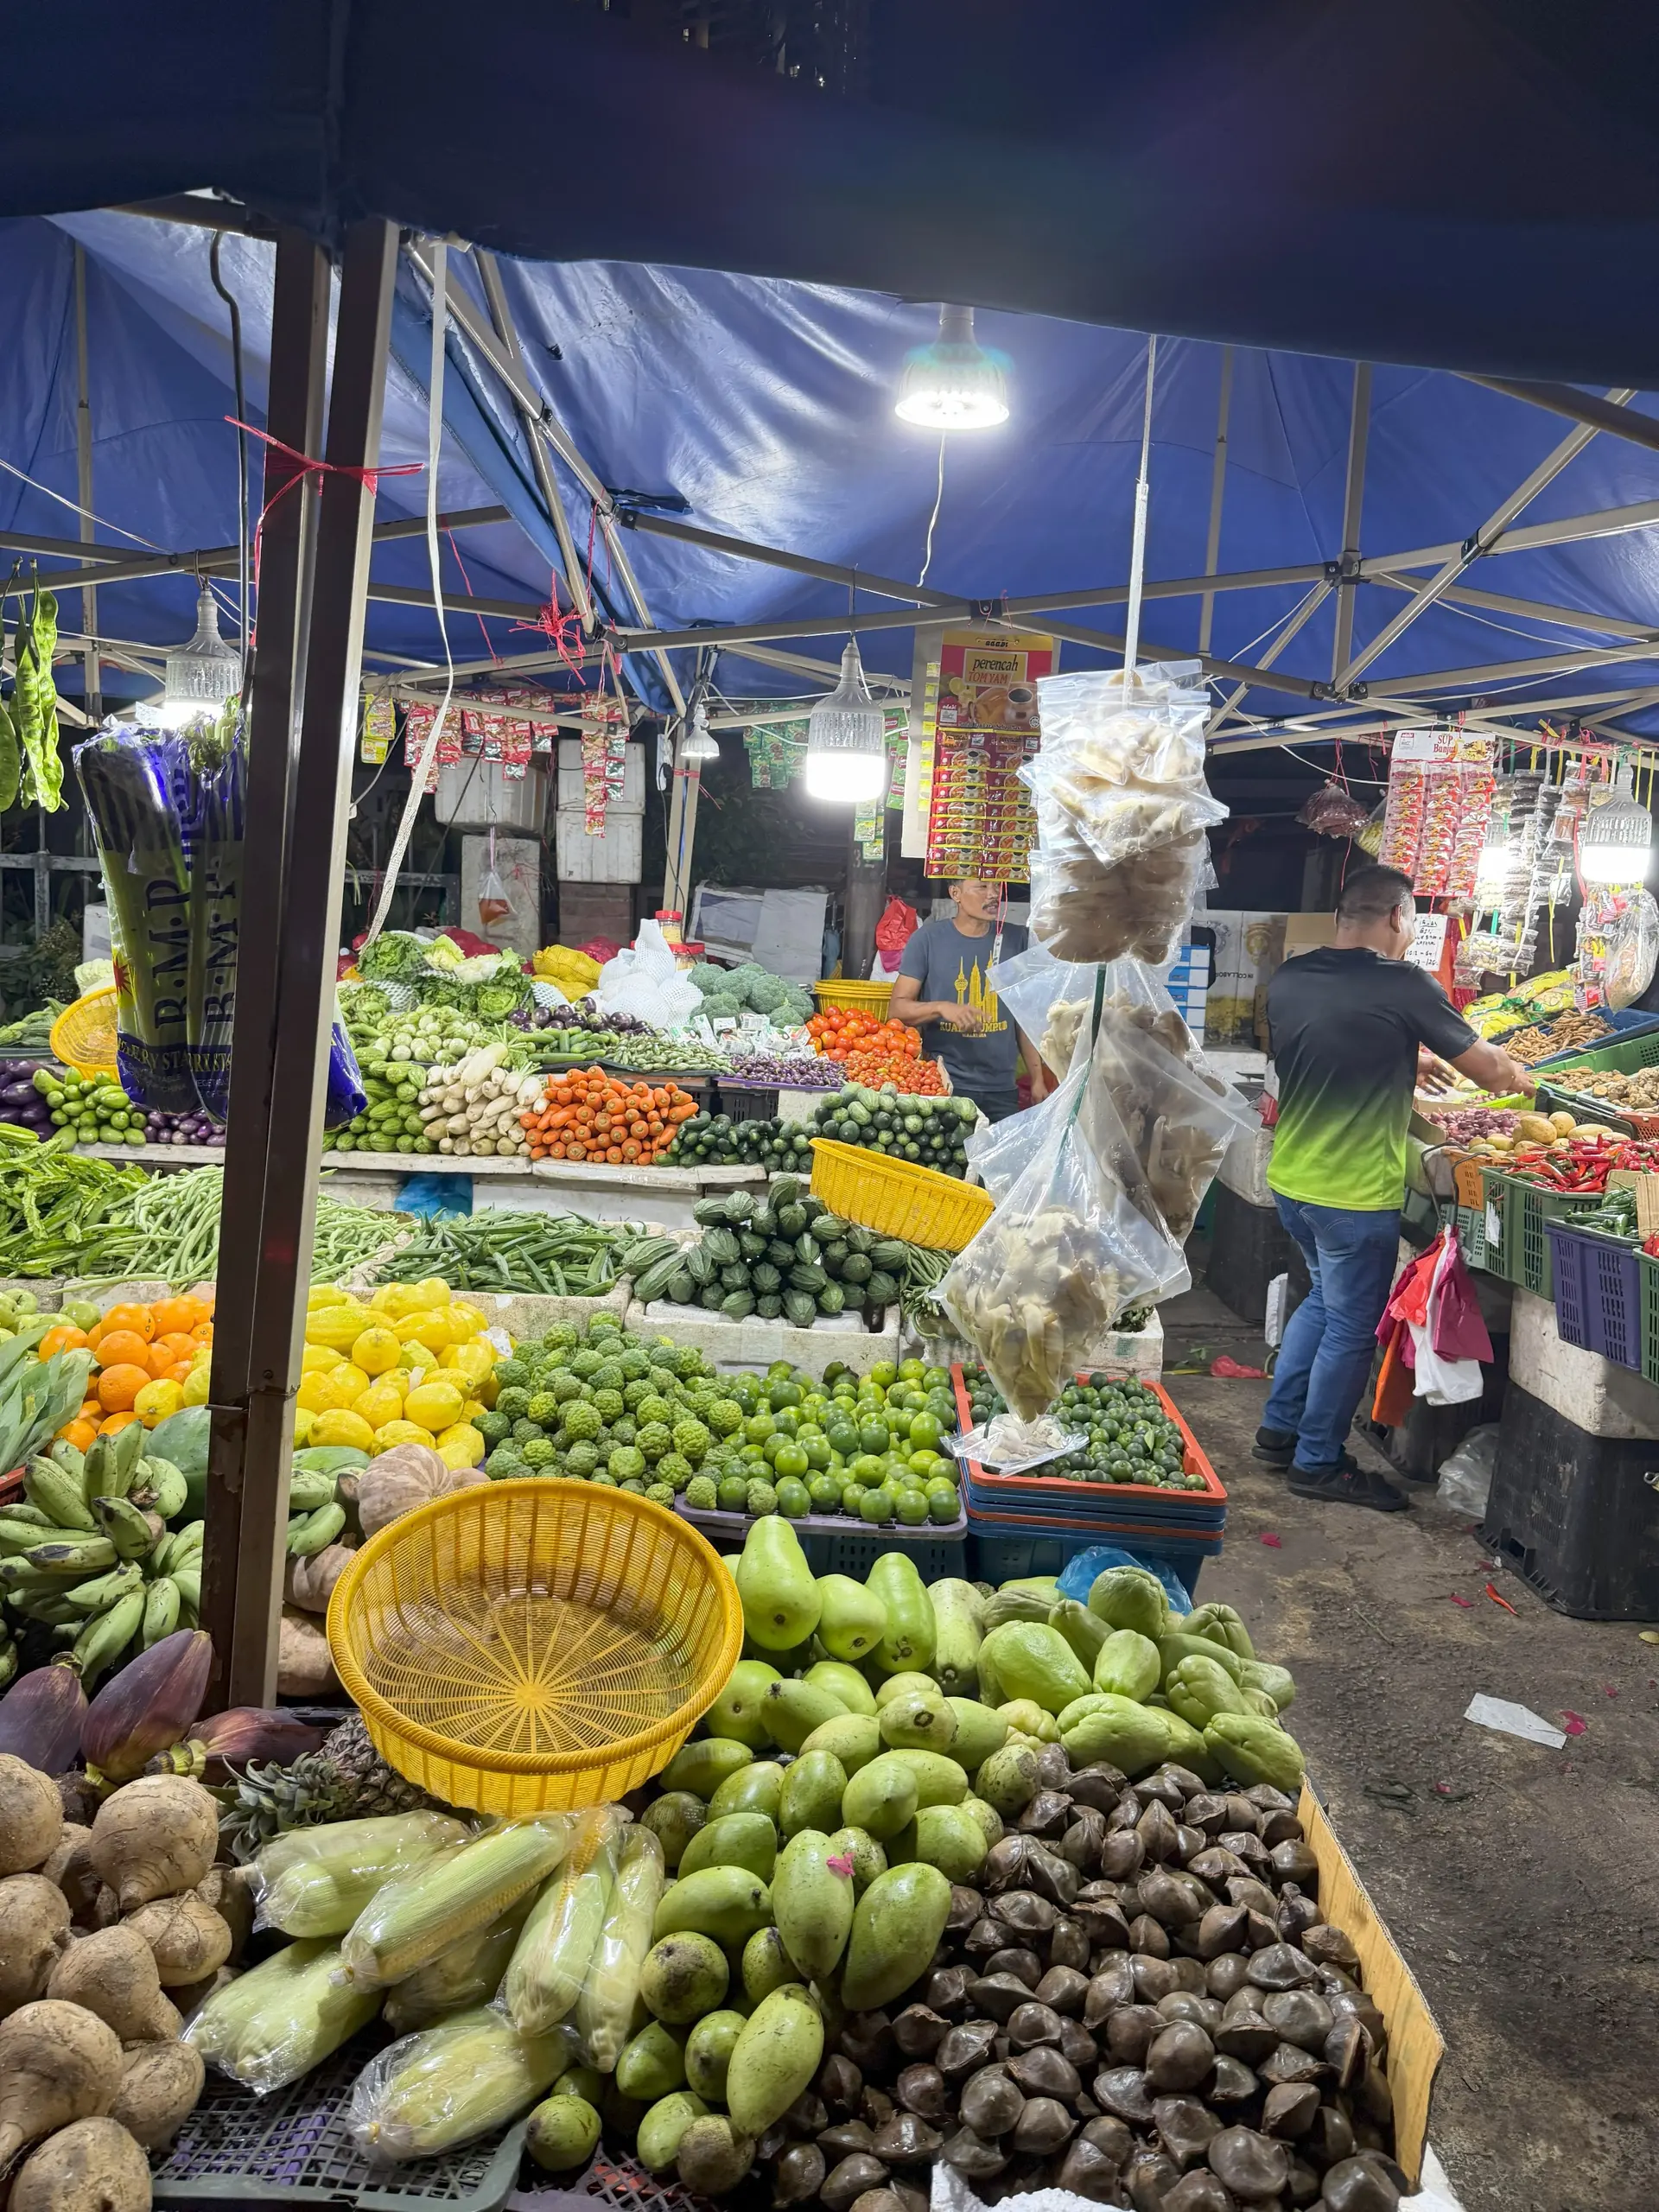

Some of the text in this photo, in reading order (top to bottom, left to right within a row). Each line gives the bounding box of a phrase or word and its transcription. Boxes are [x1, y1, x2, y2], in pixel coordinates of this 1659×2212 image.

[973, 655, 1018, 671] perencah
[969, 671, 1008, 684] TOM YAM
[1437, 734, 1453, 744] SUP
